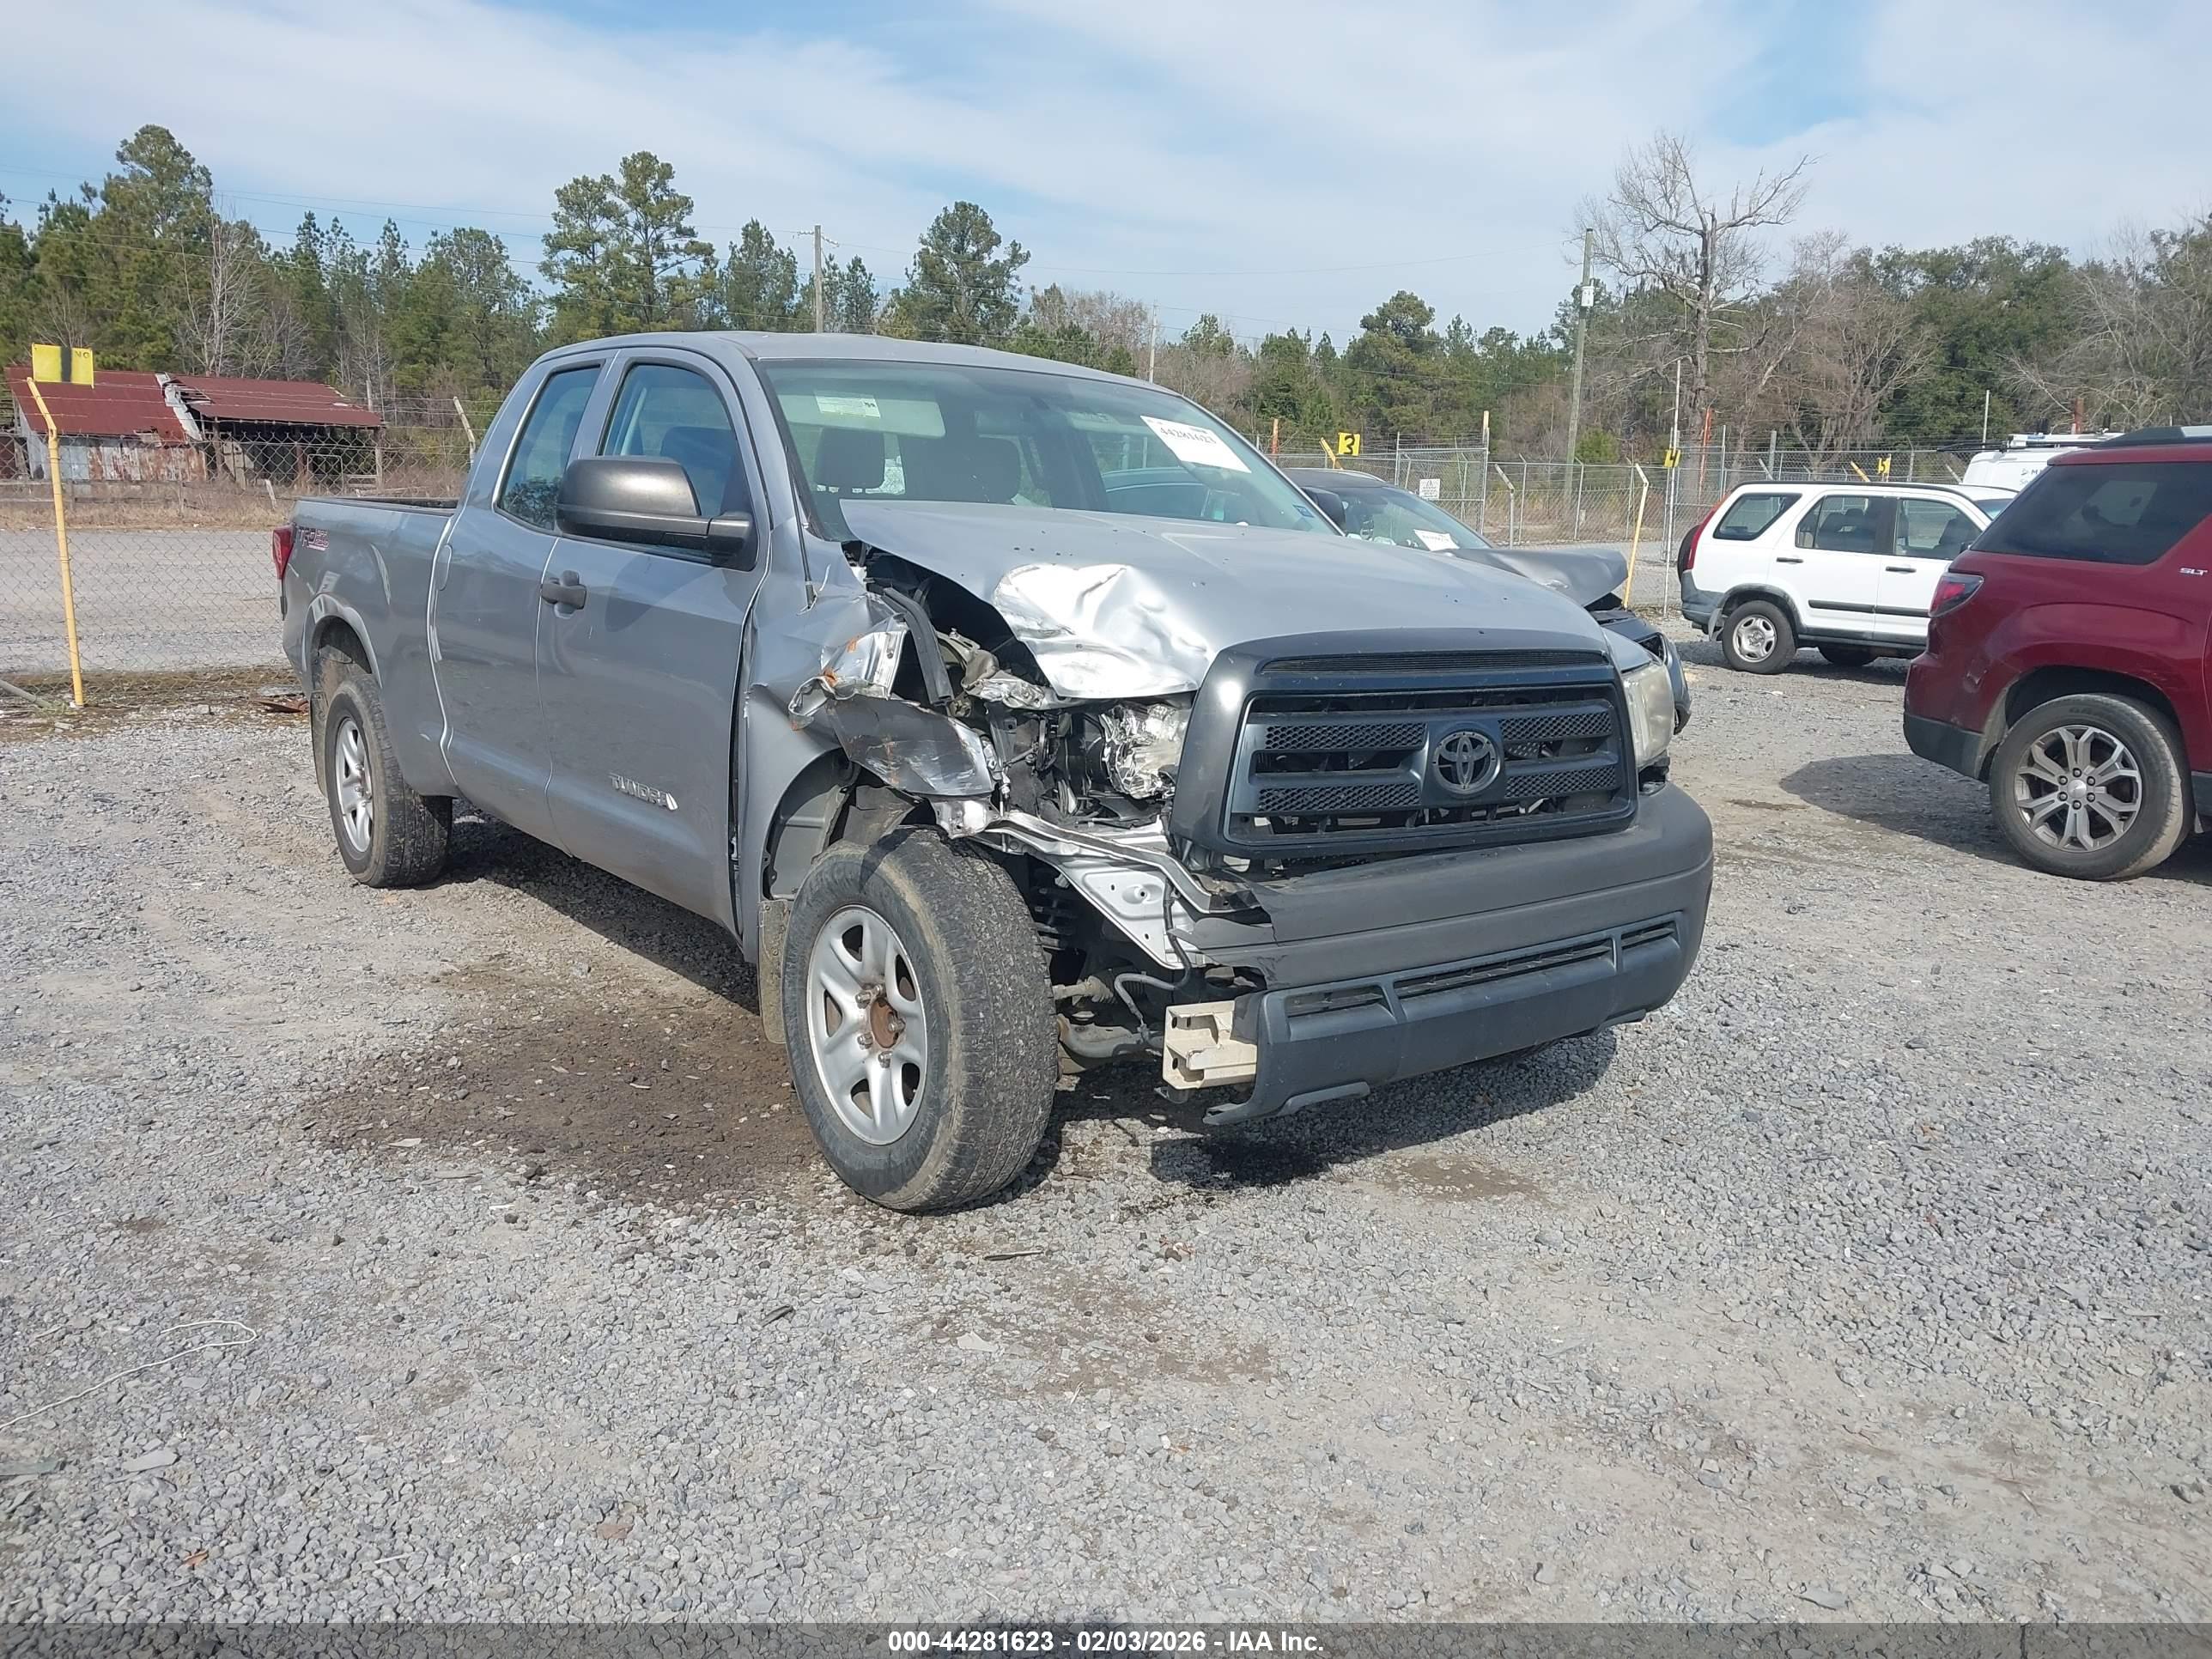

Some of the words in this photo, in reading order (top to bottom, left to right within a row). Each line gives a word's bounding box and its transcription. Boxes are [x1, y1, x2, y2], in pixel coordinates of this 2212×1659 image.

[1344, 434, 1356, 455] 3
[1669, 449, 1679, 468] 4
[1880, 457, 1887, 473] 5
[2180, 568, 2209, 576] SLT
[607, 772, 678, 811] TUNDRA
